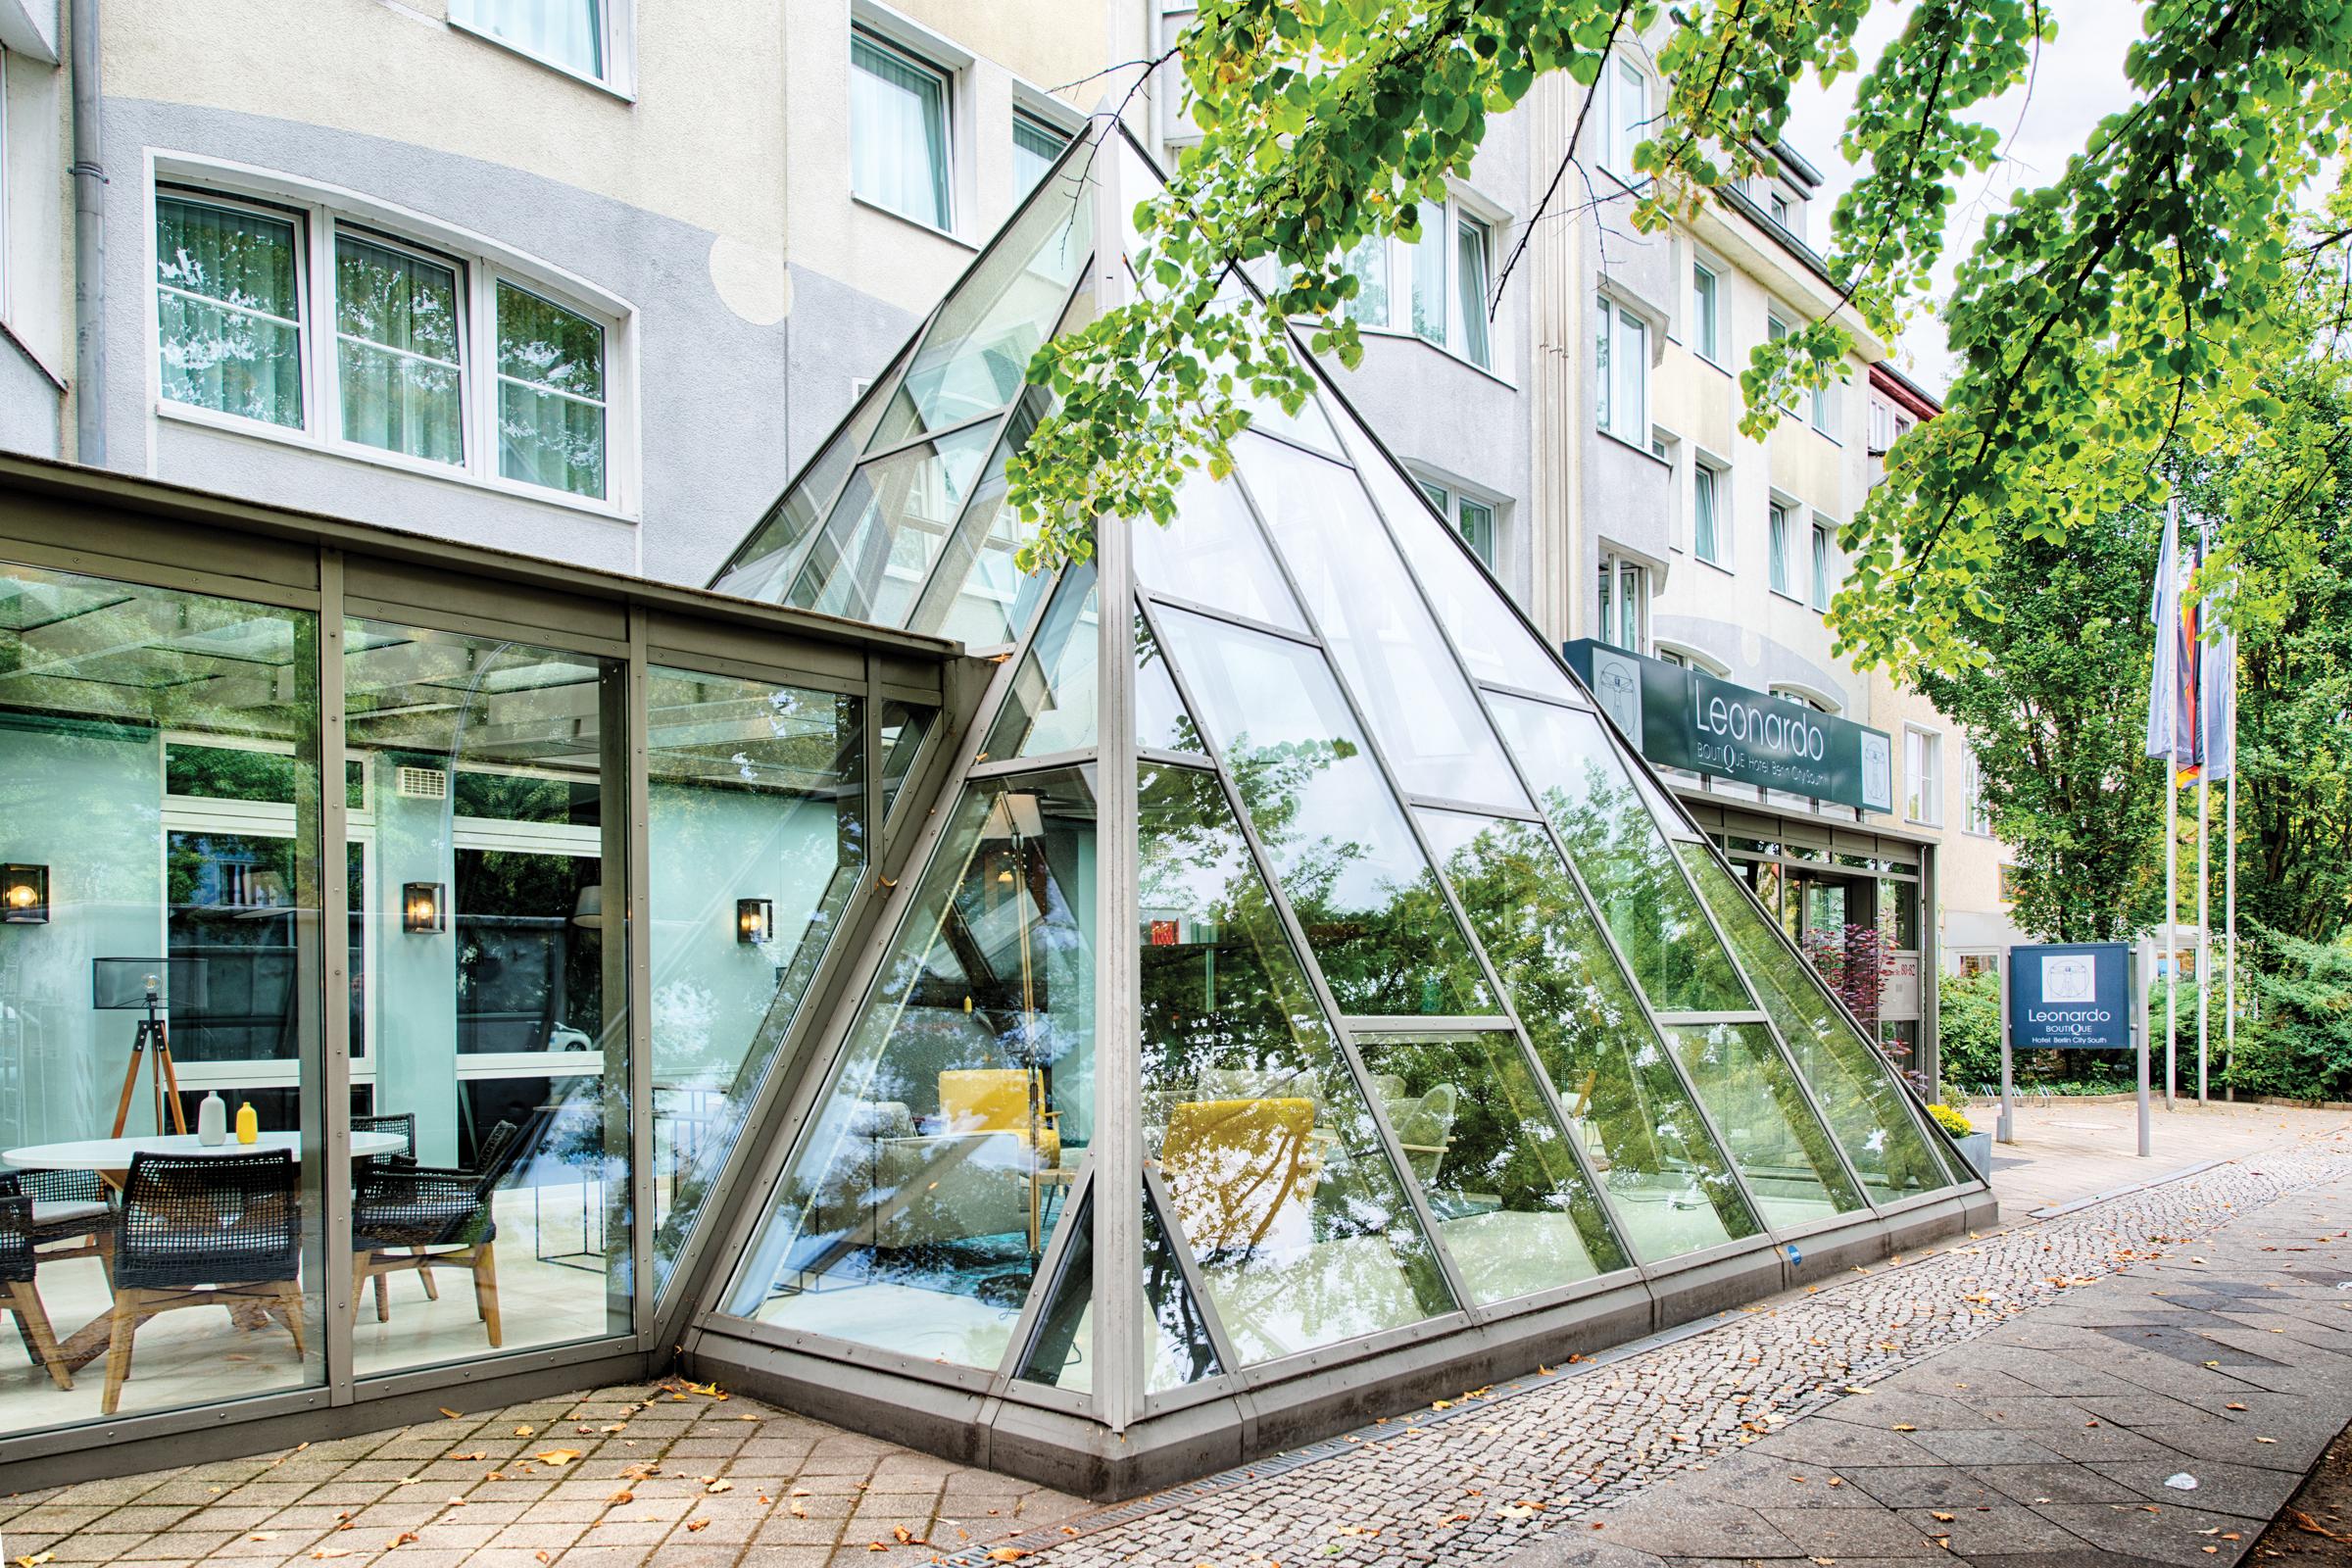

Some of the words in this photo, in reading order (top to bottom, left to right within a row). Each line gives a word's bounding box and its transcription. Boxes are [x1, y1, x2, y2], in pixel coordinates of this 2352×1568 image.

[1695, 679, 1824, 761] Leonardo
[1697, 742, 1745, 773] BOUTIQUE
[1748, 756, 1768, 773] Hotel
[1772, 760, 1789, 778] Bern
[2029, 1008, 2110, 1022] Leonardo
[2045, 1023, 2092, 1036] BOUTIQUE
